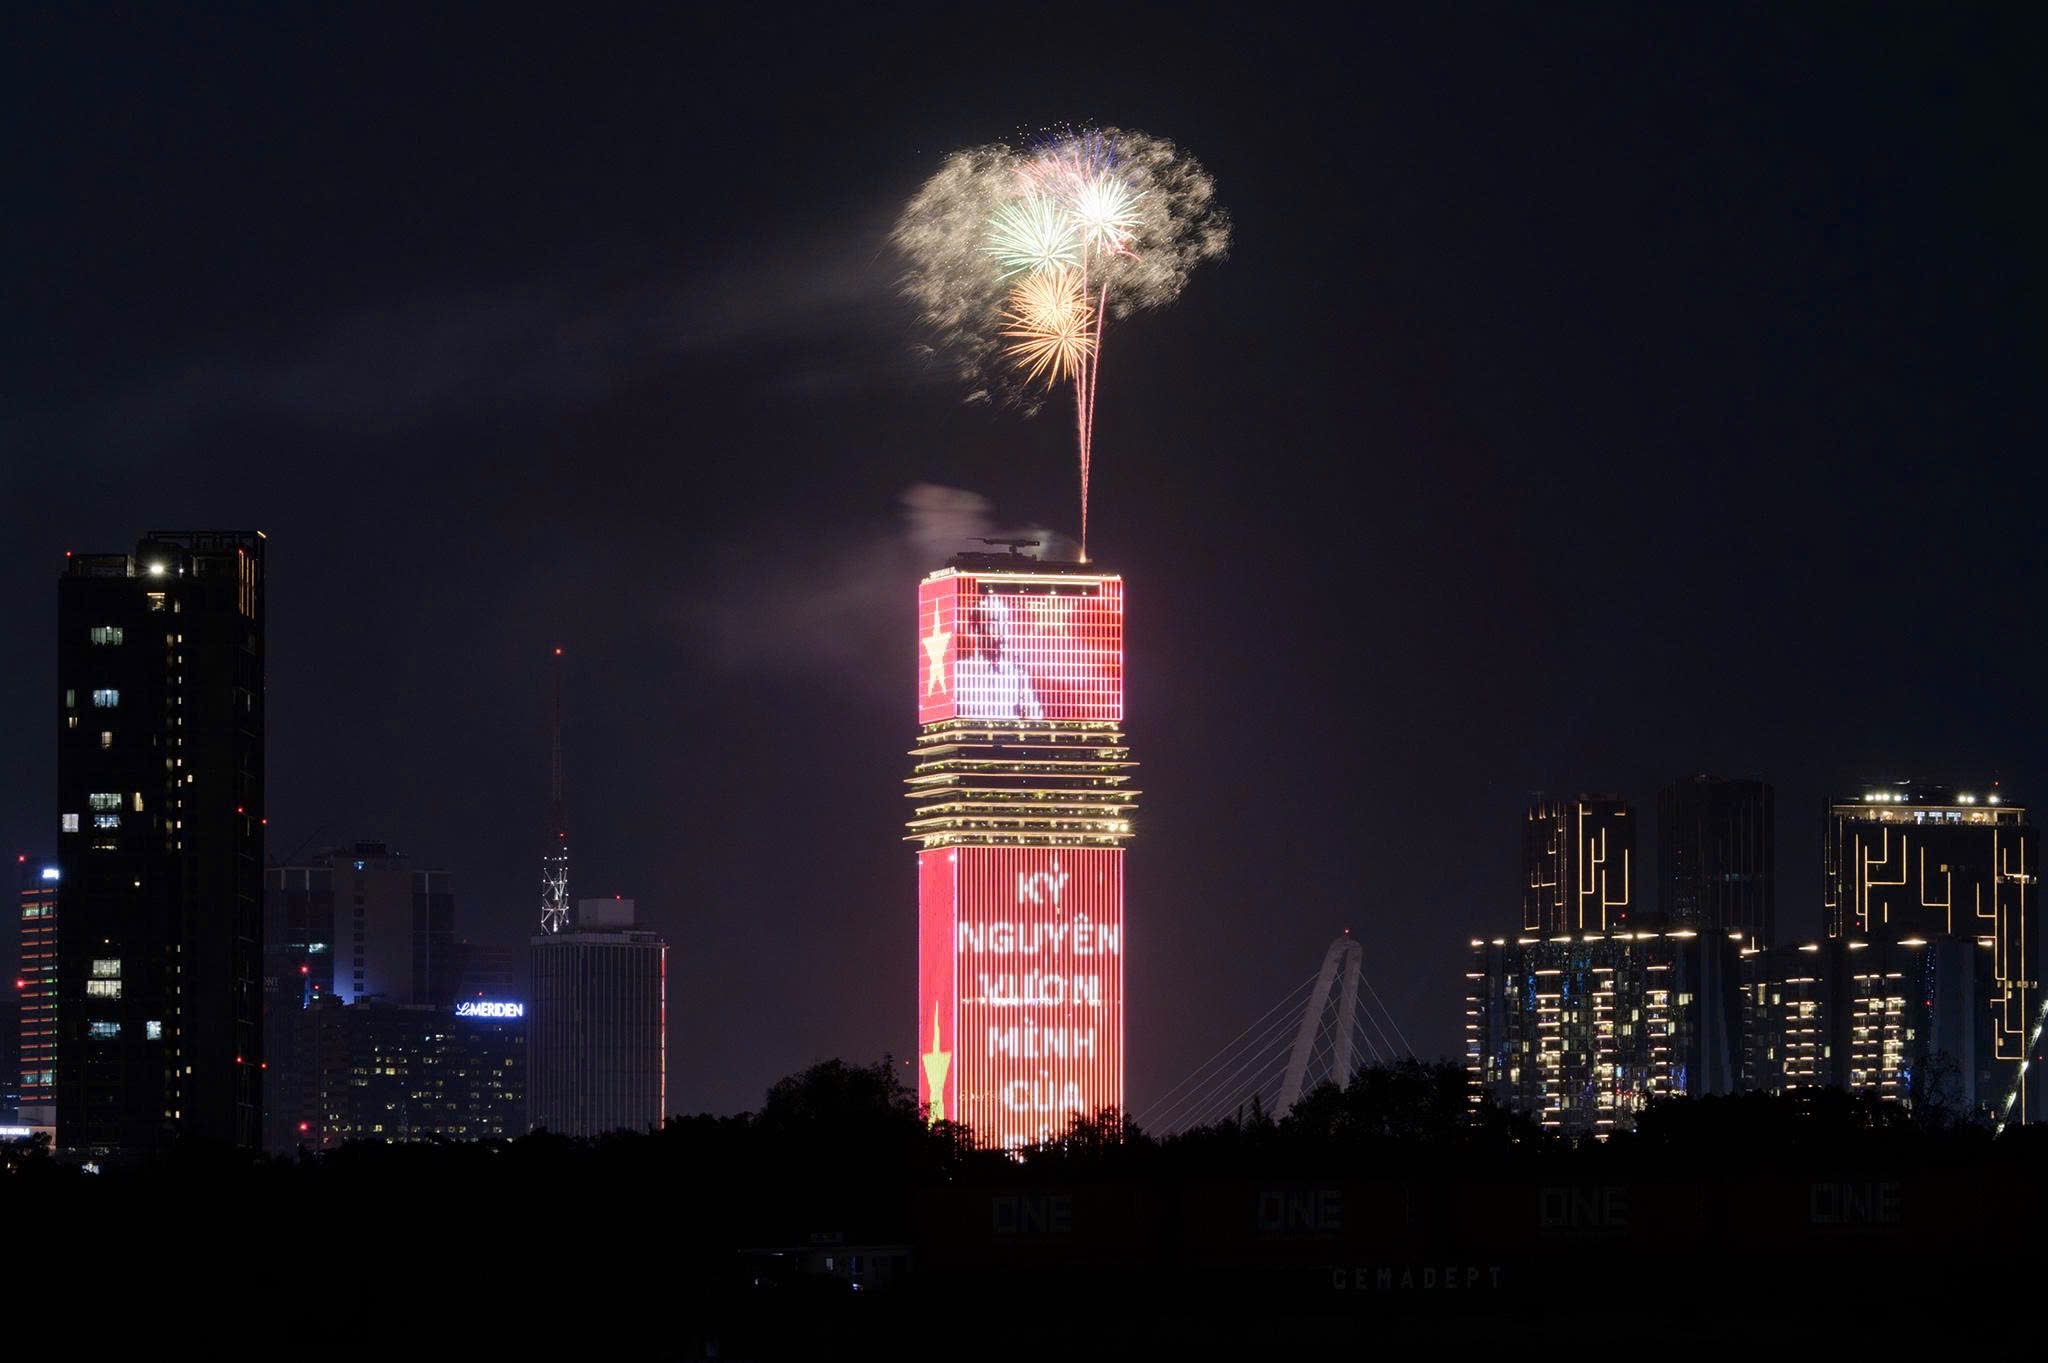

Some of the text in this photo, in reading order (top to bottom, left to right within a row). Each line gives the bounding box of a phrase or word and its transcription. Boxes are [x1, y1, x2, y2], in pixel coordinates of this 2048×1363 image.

[958, 912, 1120, 955] NGUYÊN
[988, 1017, 1095, 1058] MÌNH
[992, 1199, 1072, 1233] ONE
[1257, 1191, 1344, 1231] ONE
[1539, 1186, 1628, 1225] ONE
[1809, 1183, 1904, 1223] ONE
[1332, 1266, 1502, 1289] GEMADEPT
